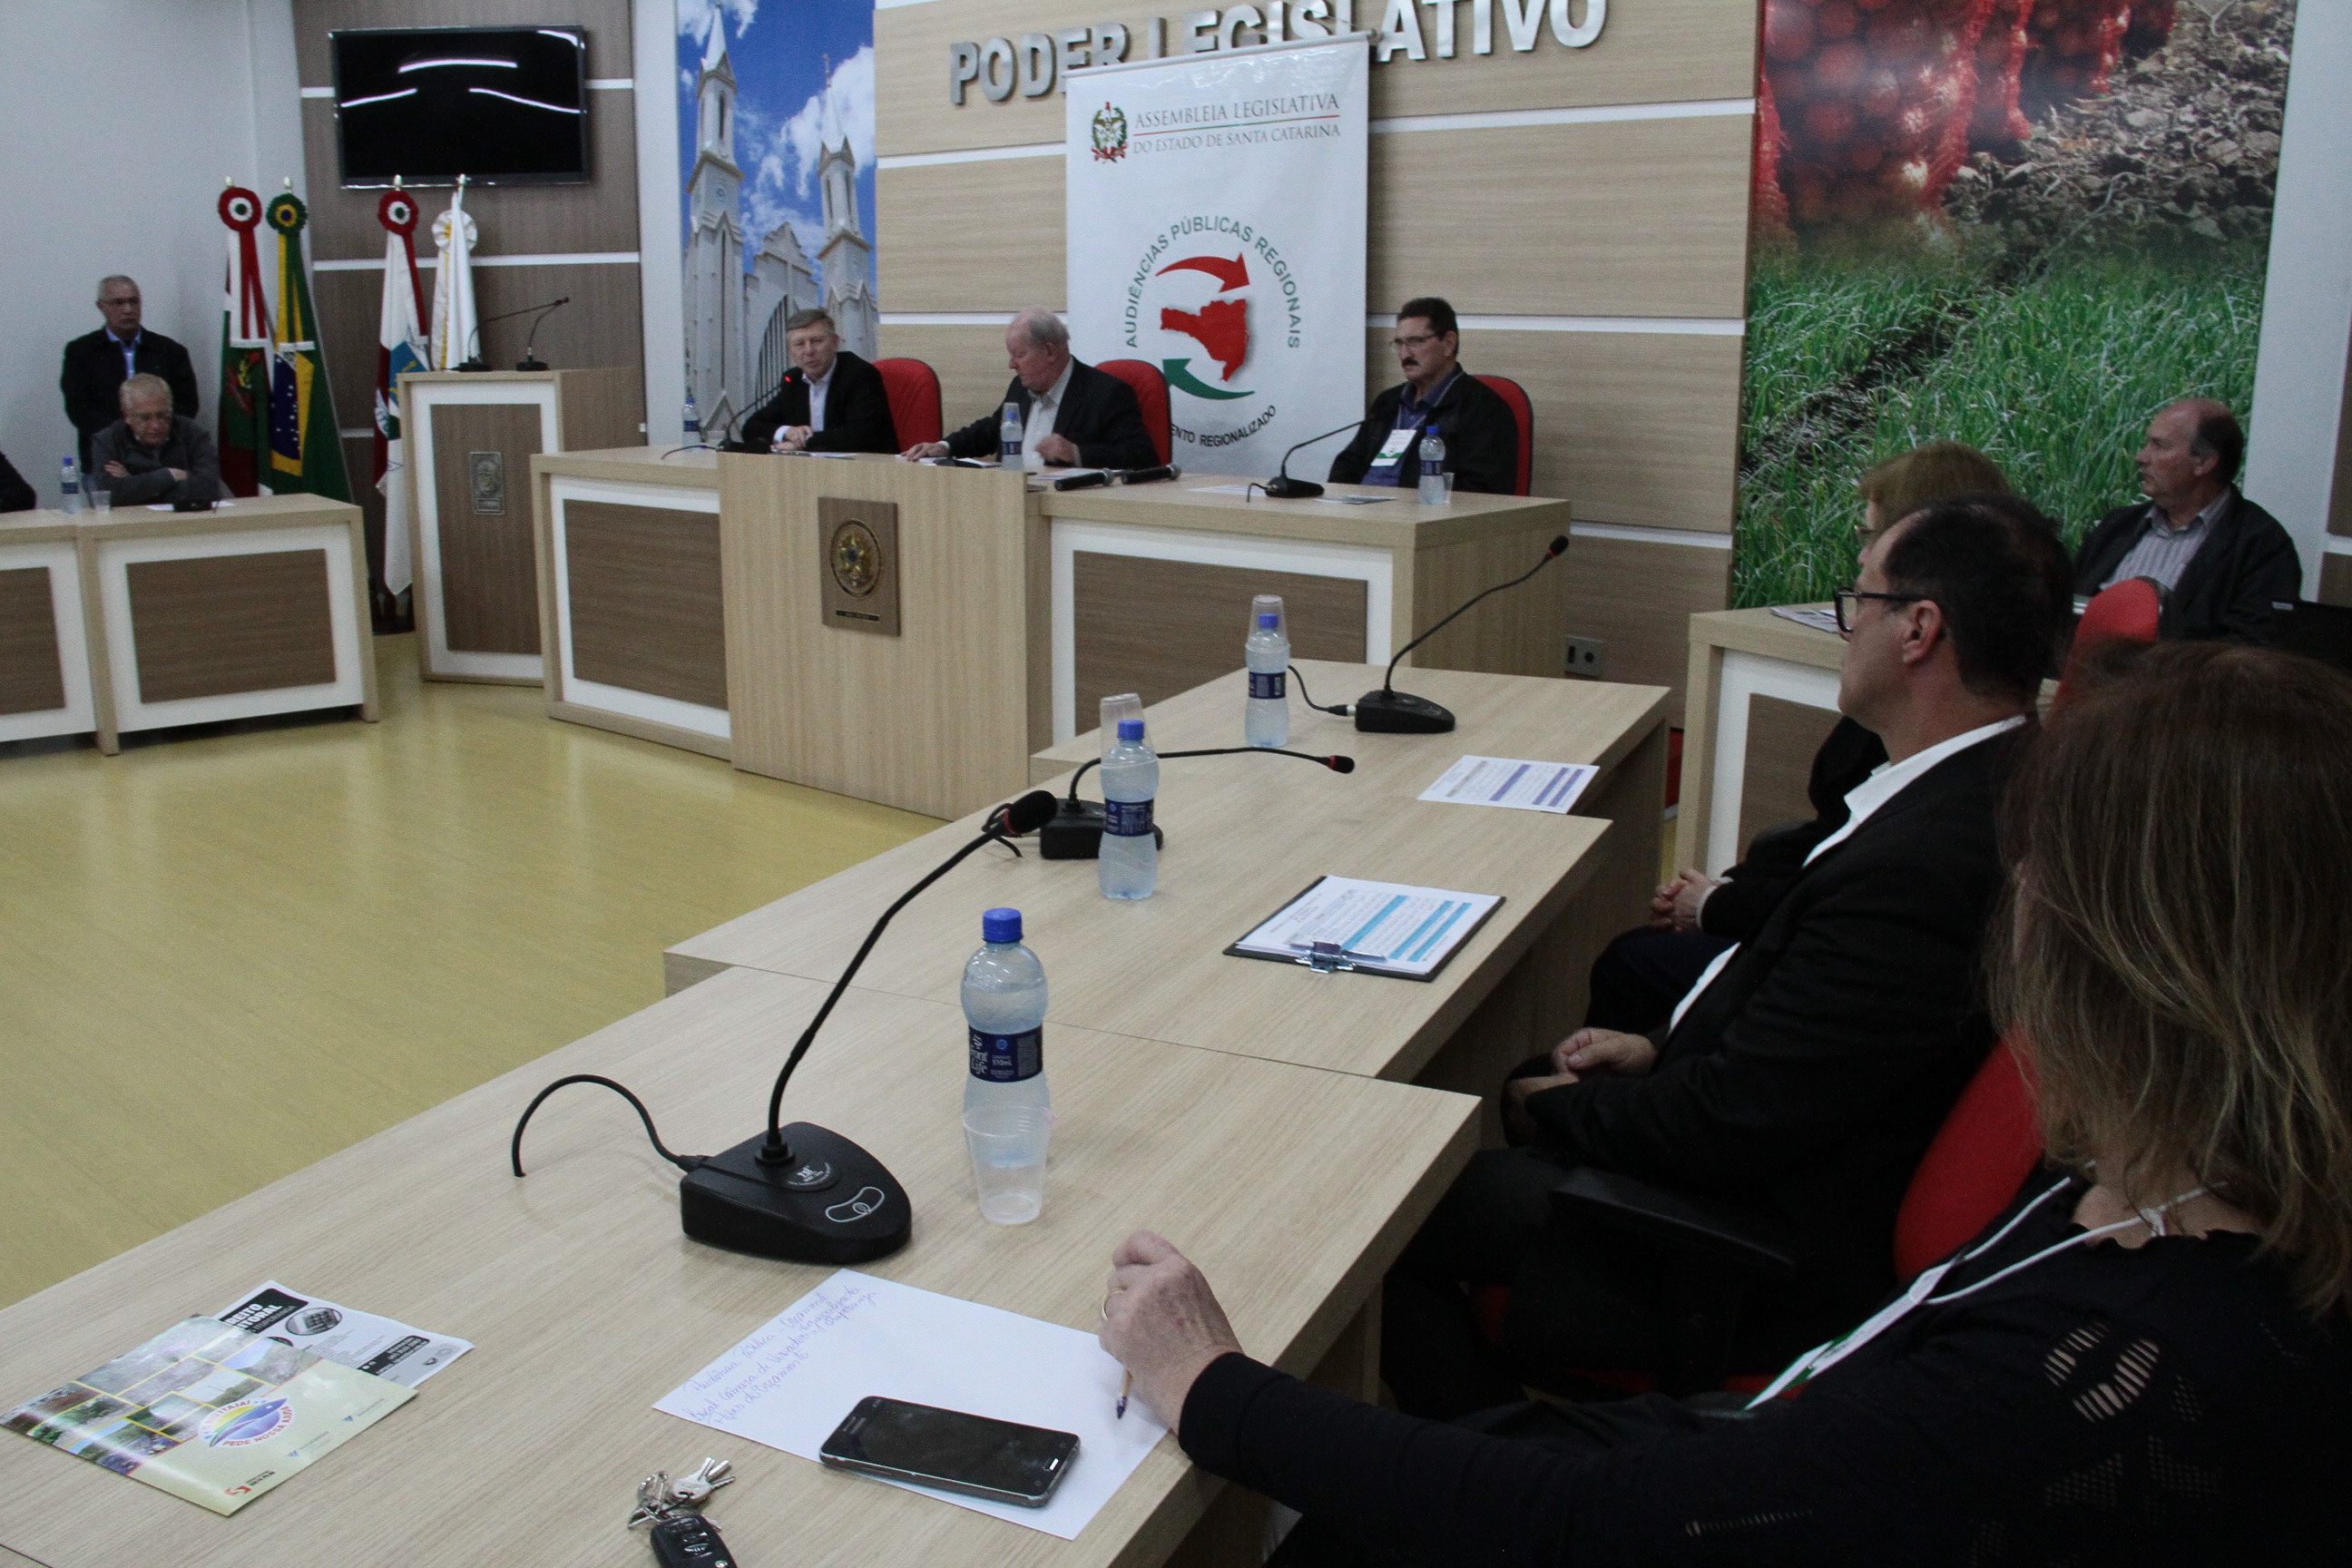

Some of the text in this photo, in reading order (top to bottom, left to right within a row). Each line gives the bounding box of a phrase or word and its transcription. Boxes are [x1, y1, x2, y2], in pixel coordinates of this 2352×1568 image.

[950, 23, 1129, 104] PODER
[1134, 93, 1340, 129] ASSEMBLEIA LEGISLATIVA
[1133, 123, 1341, 154] DO ESTADO DE SANTA CATARINA
[1125, 216, 1301, 348] AUDIÊNCIAS PÚBLICAS REGIONAIS
[1171, 405, 1276, 447] ENTO REGIONALIZADO
[223, 1302, 264, 1326] REITO
[236, 1304, 284, 1329] ITORAL
[254, 1424, 287, 1443] NOSSA
